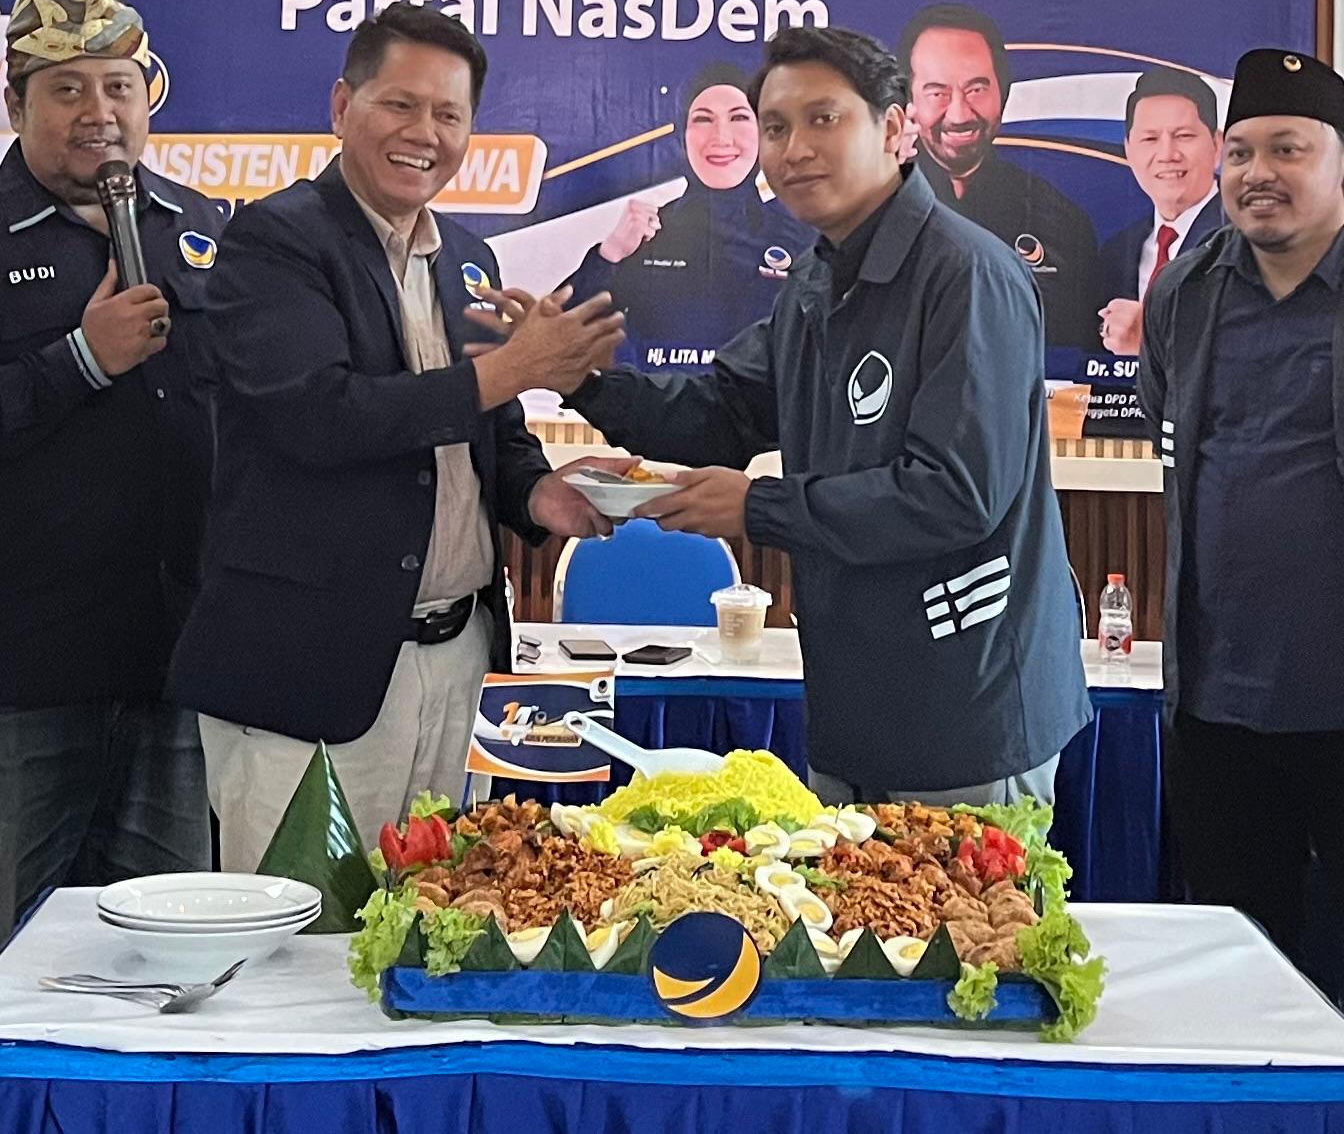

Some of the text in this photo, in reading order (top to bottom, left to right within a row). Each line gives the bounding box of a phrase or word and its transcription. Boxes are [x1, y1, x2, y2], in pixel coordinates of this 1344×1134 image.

[142, 142, 301, 189] NSISTEN
[8, 265, 55, 284] BUDI
[669, 348, 699, 364] LITA
[1086, 359, 1110, 377] Dr.
